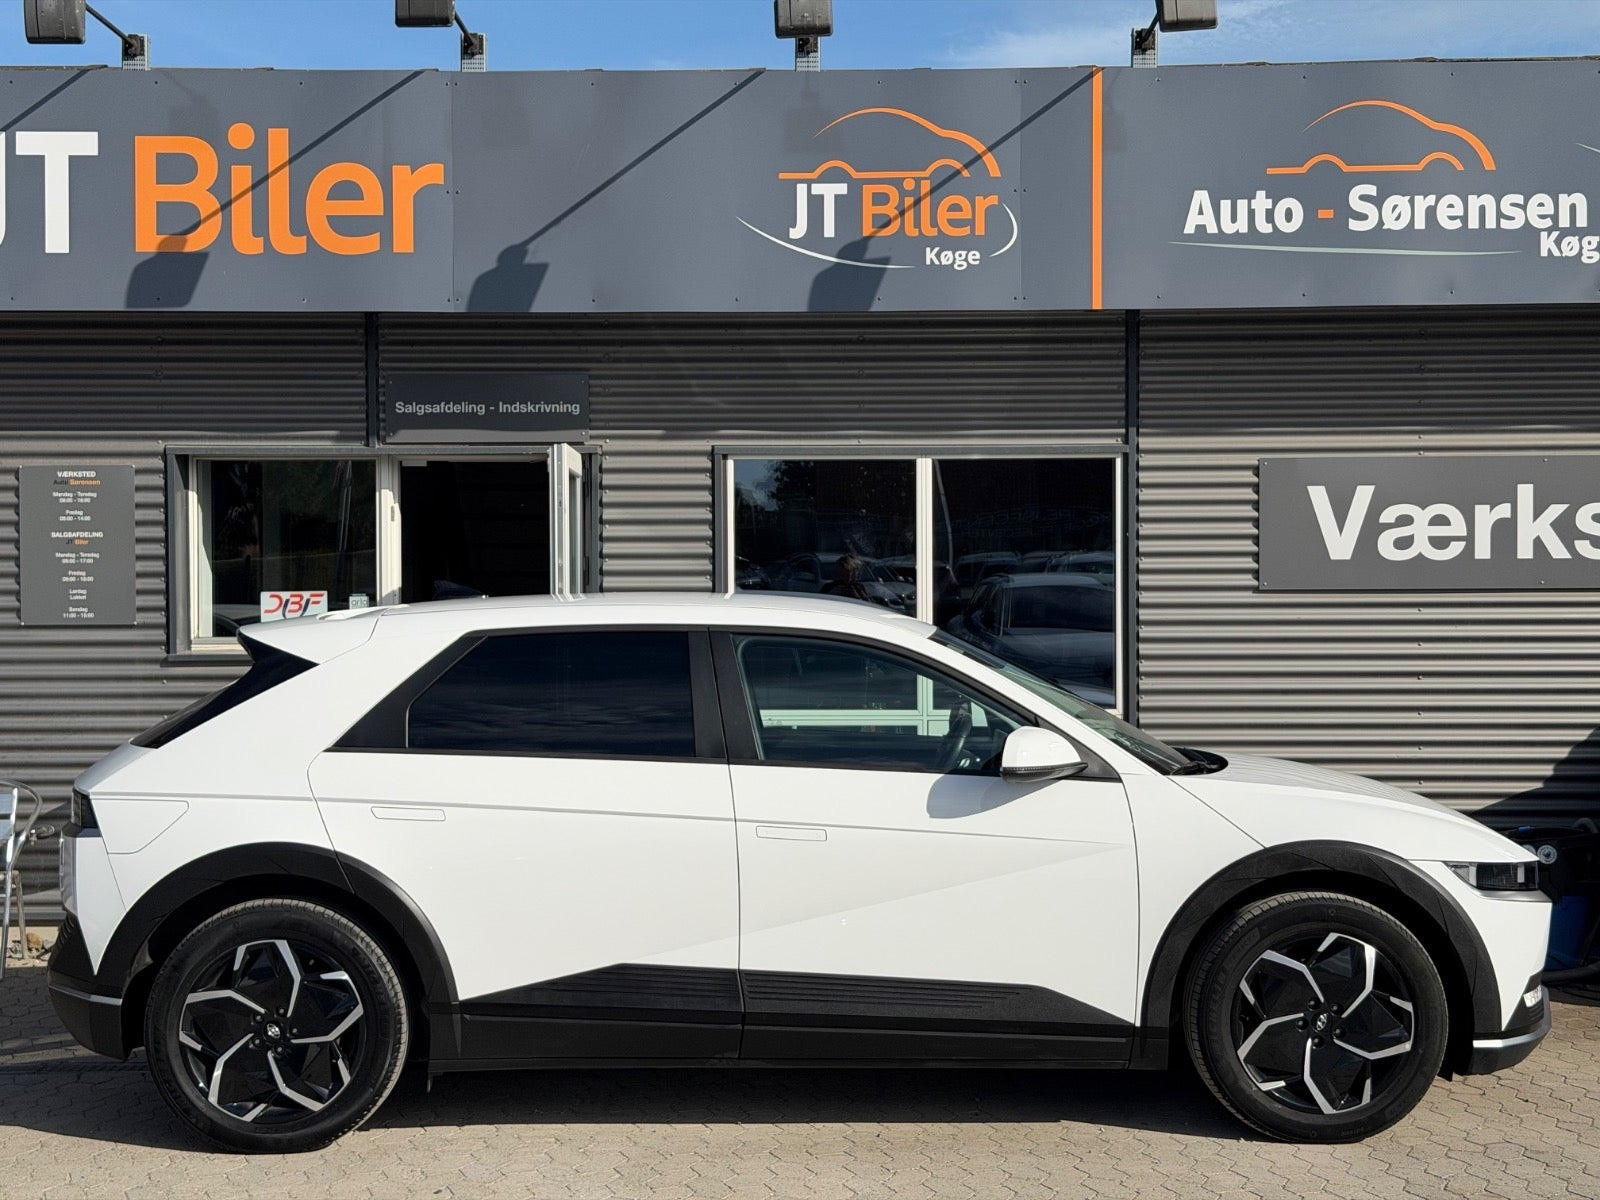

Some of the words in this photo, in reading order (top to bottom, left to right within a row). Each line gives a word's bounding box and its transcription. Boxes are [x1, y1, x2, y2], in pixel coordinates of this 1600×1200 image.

[0, 131, 99, 253] T
[134, 122, 445, 256] Biler
[788, 183, 848, 239] JT
[862, 178, 999, 237] Biler
[1183, 189, 1304, 234] Auto
[1317, 209, 1334, 219] -
[1347, 183, 1588, 232] Sørensen
[925, 247, 981, 270] Køge
[395, 401, 486, 416] Salgsafdeling
[499, 401, 580, 416] Indskrivning
[57, 470, 97, 478] VÆRKSTED
